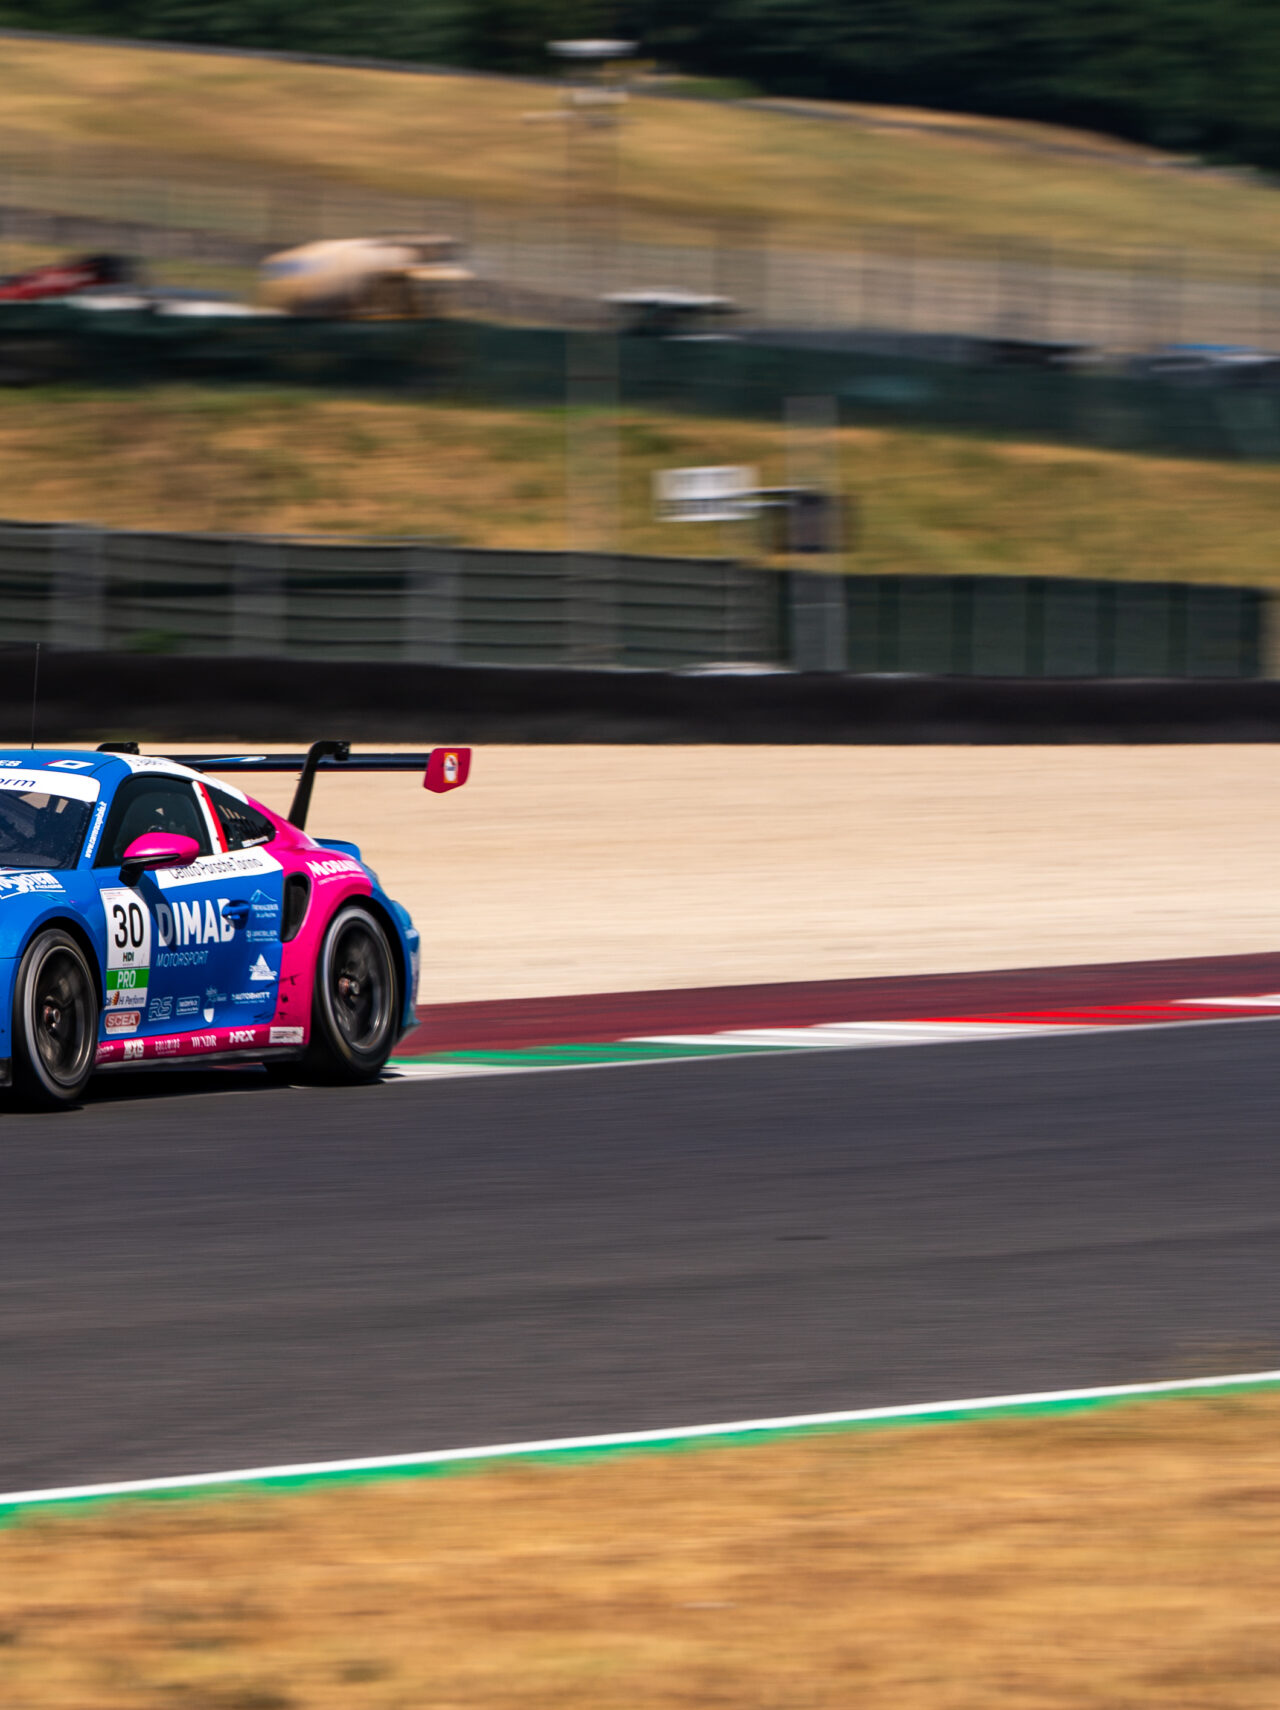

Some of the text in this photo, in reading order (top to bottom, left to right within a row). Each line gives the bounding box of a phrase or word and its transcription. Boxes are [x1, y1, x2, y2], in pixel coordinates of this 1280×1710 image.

[113, 902, 144, 949] 30
[155, 898, 235, 947] DIMAB
[122, 952, 135, 962] HDI
[156, 951, 209, 967] MOTORSPORT
[117, 970, 137, 988] PRO
[108, 1014, 137, 1026] SCEA
